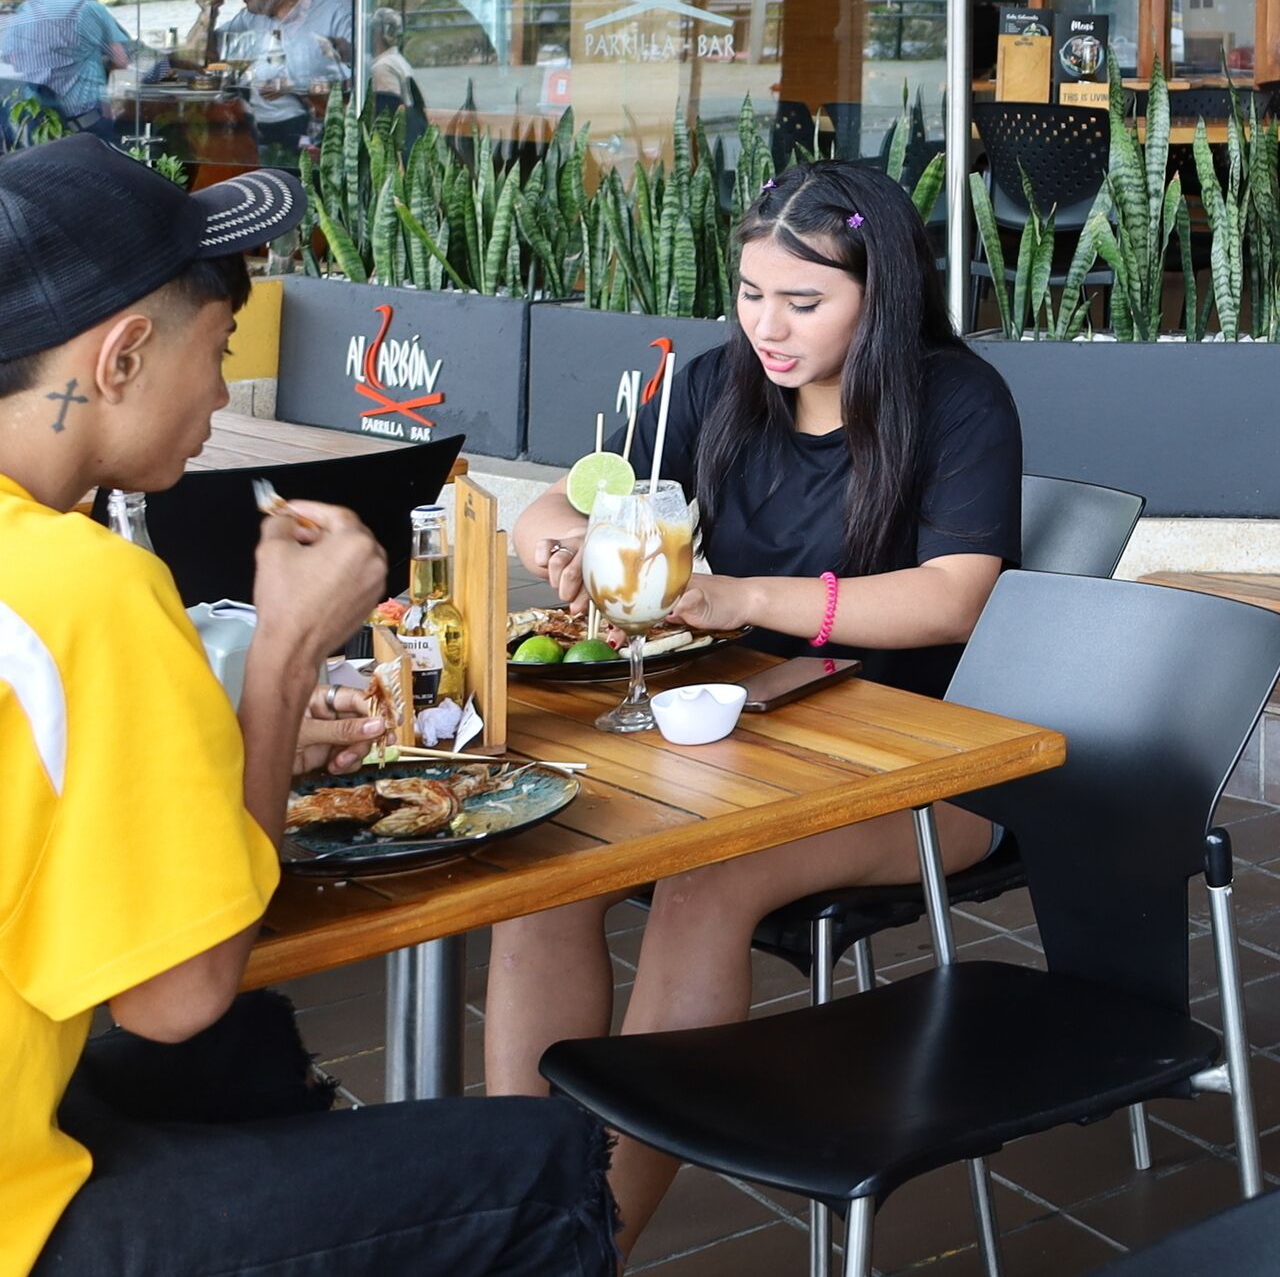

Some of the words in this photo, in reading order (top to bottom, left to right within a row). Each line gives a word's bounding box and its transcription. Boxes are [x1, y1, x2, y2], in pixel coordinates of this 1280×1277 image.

[584, 33, 676, 57] PARRILLA
[697, 33, 735, 57] BAR
[1063, 92, 1078, 102] THIS
[1081, 92, 1089, 102] IS
[1090, 92, 1110, 103] LIVIN
[345, 335, 366, 383] AL
[361, 416, 404, 437] PARRILLA
[410, 426, 431, 441] BAR
[402, 639, 429, 650] onita
